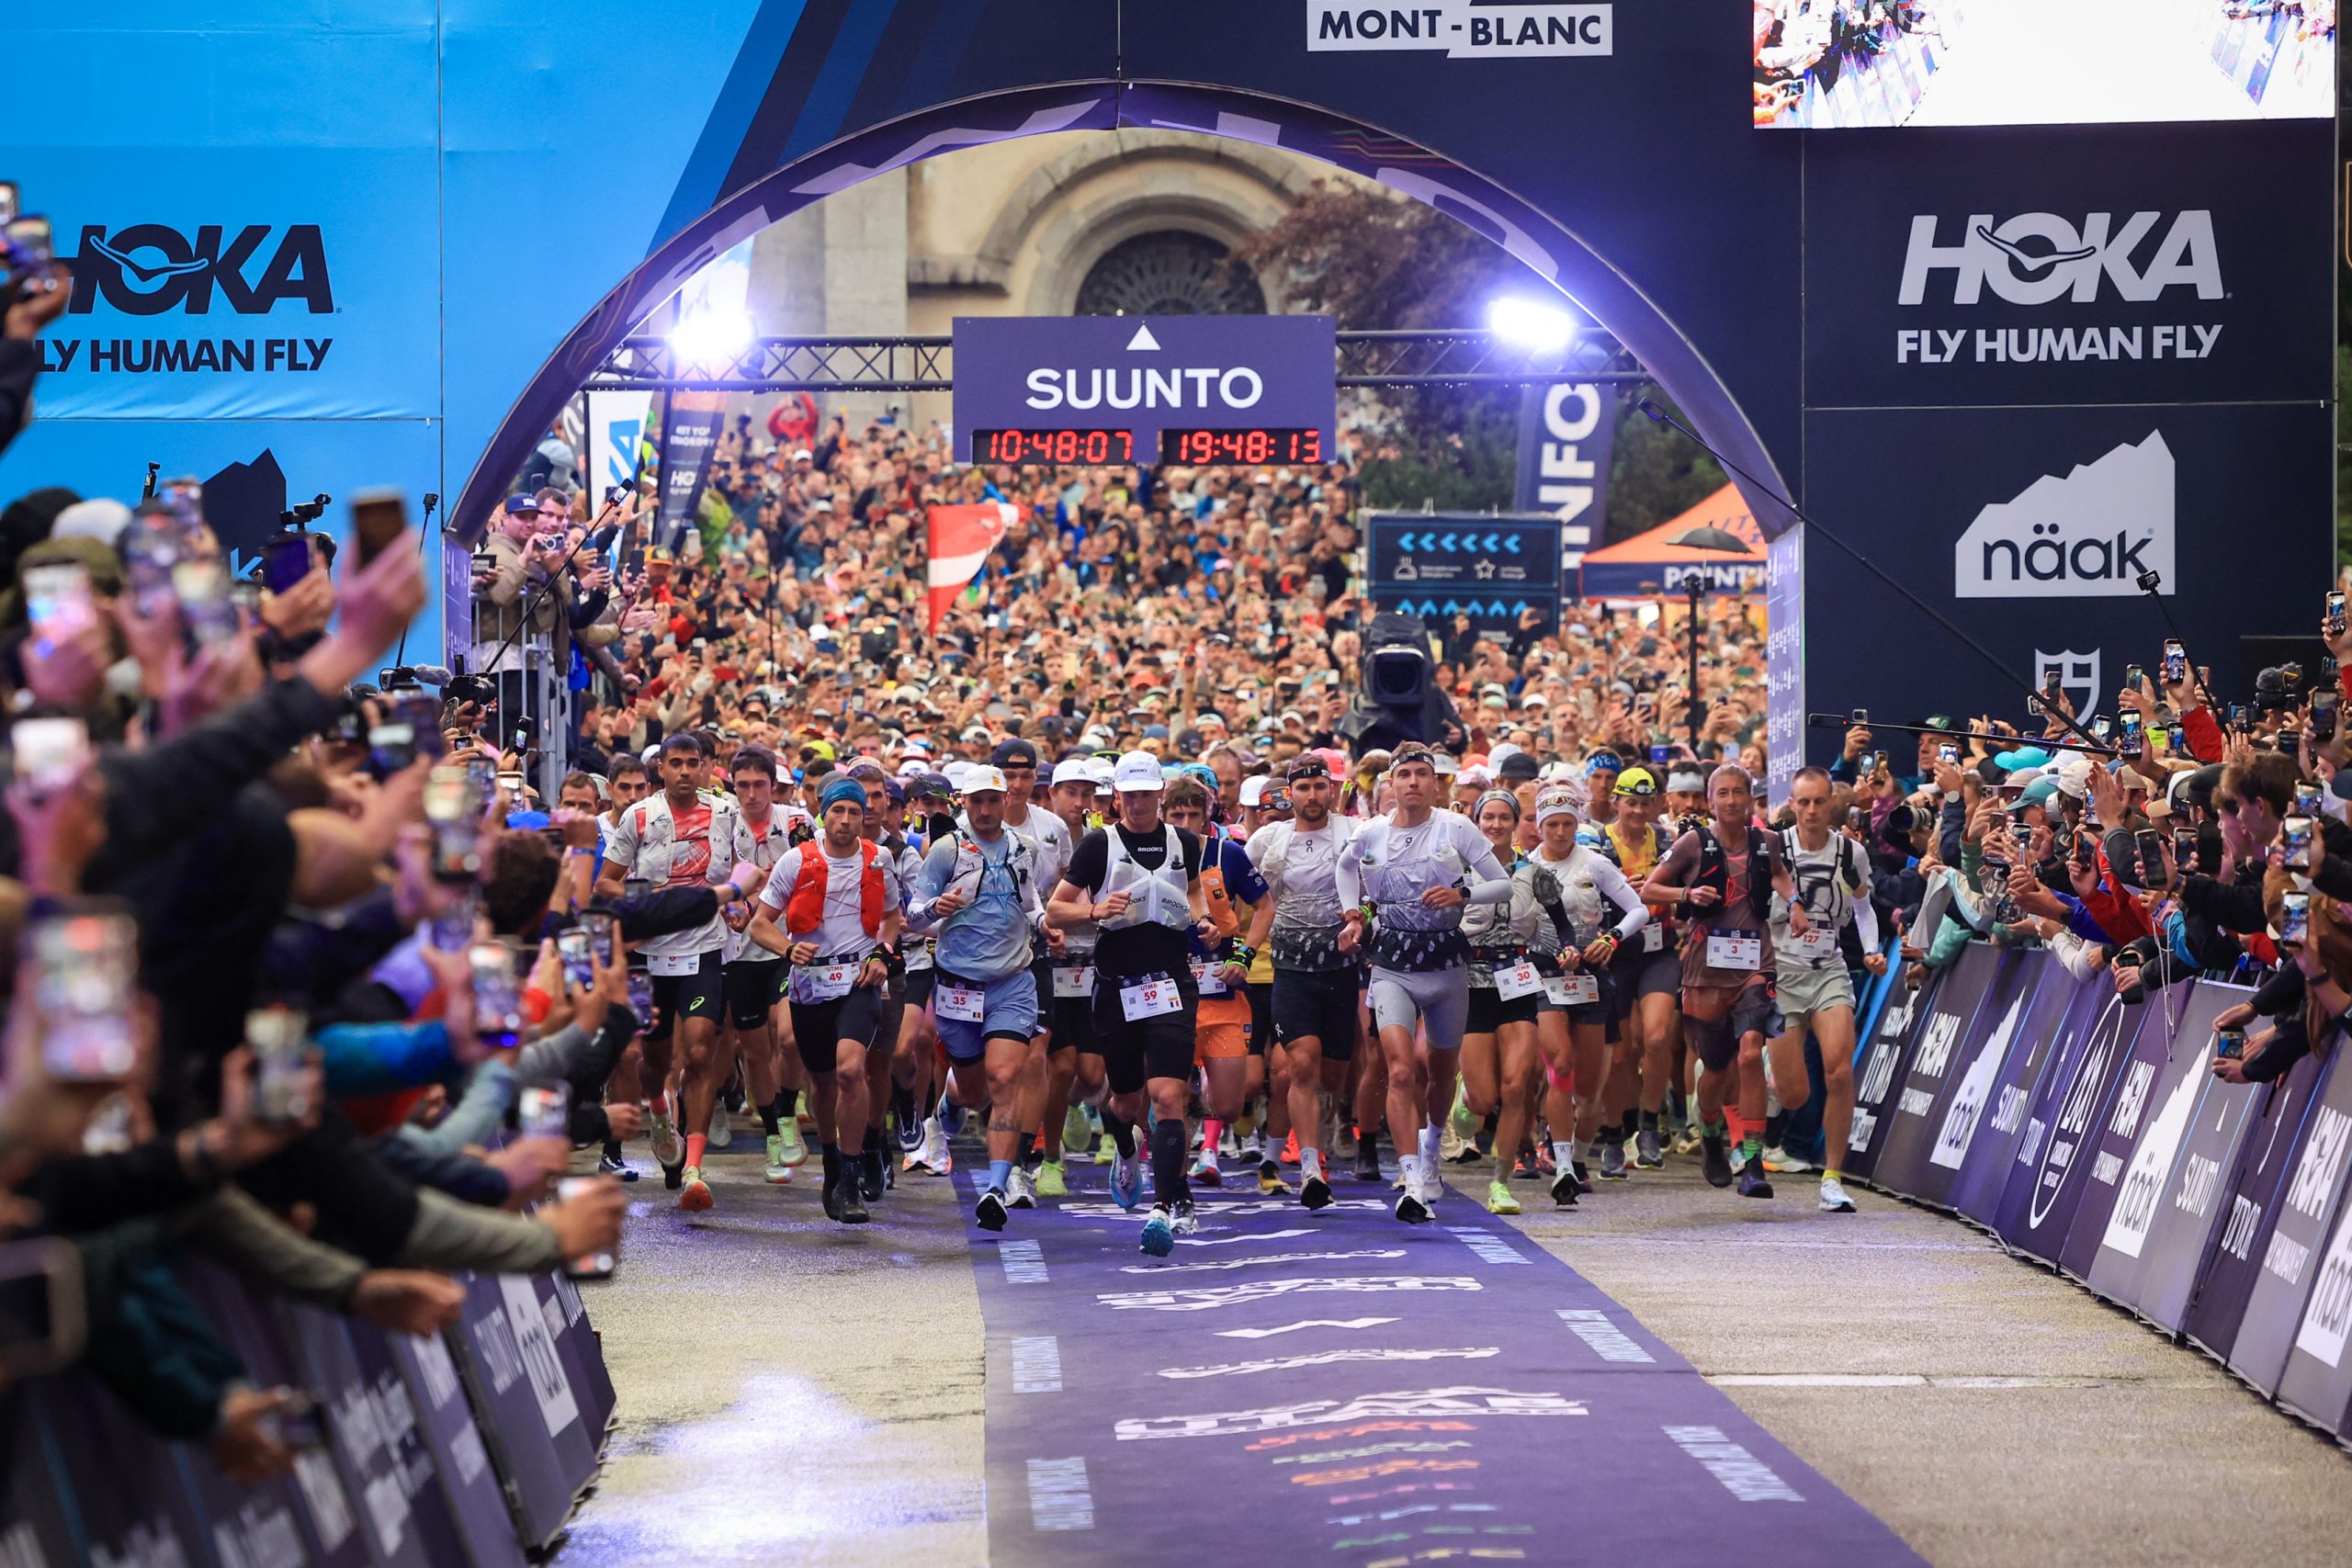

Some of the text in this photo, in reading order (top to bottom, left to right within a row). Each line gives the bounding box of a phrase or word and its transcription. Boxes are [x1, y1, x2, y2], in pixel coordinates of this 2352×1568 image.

[1897, 210, 2224, 305] HOKA
[35, 338, 334, 373] LY HUMAN FLY
[1897, 324, 2223, 364] FLY HUMAN FLY
[1025, 367, 1263, 410] SUUNTO
[670, 470, 696, 486] HO
[1983, 523, 2153, 582] näak
[1128, 895, 1147, 906] OOKS
[1160, 897, 1188, 911] BROOKS
[1803, 934, 1820, 943] 127
[829, 972, 842, 982] 49
[1140, 984, 1158, 992] UTMB
[1144, 990, 1158, 1001] 59
[1517, 971, 1530, 981] 30
[1564, 983, 1577, 991] 64
[953, 997, 966, 1006] 35
[1912, 1011, 1961, 1078] HOKA
[1858, 1043, 1902, 1105] UTMB
[1990, 1082, 2029, 1135] SUUNTO
[2109, 1059, 2156, 1140] HOKA
[2286, 1105, 2352, 1221] HOKA
[2115, 1151, 2164, 1235] näak
[2175, 1153, 2220, 1218] SUUNTO
[2221, 1193, 2262, 1262] TUDOR
